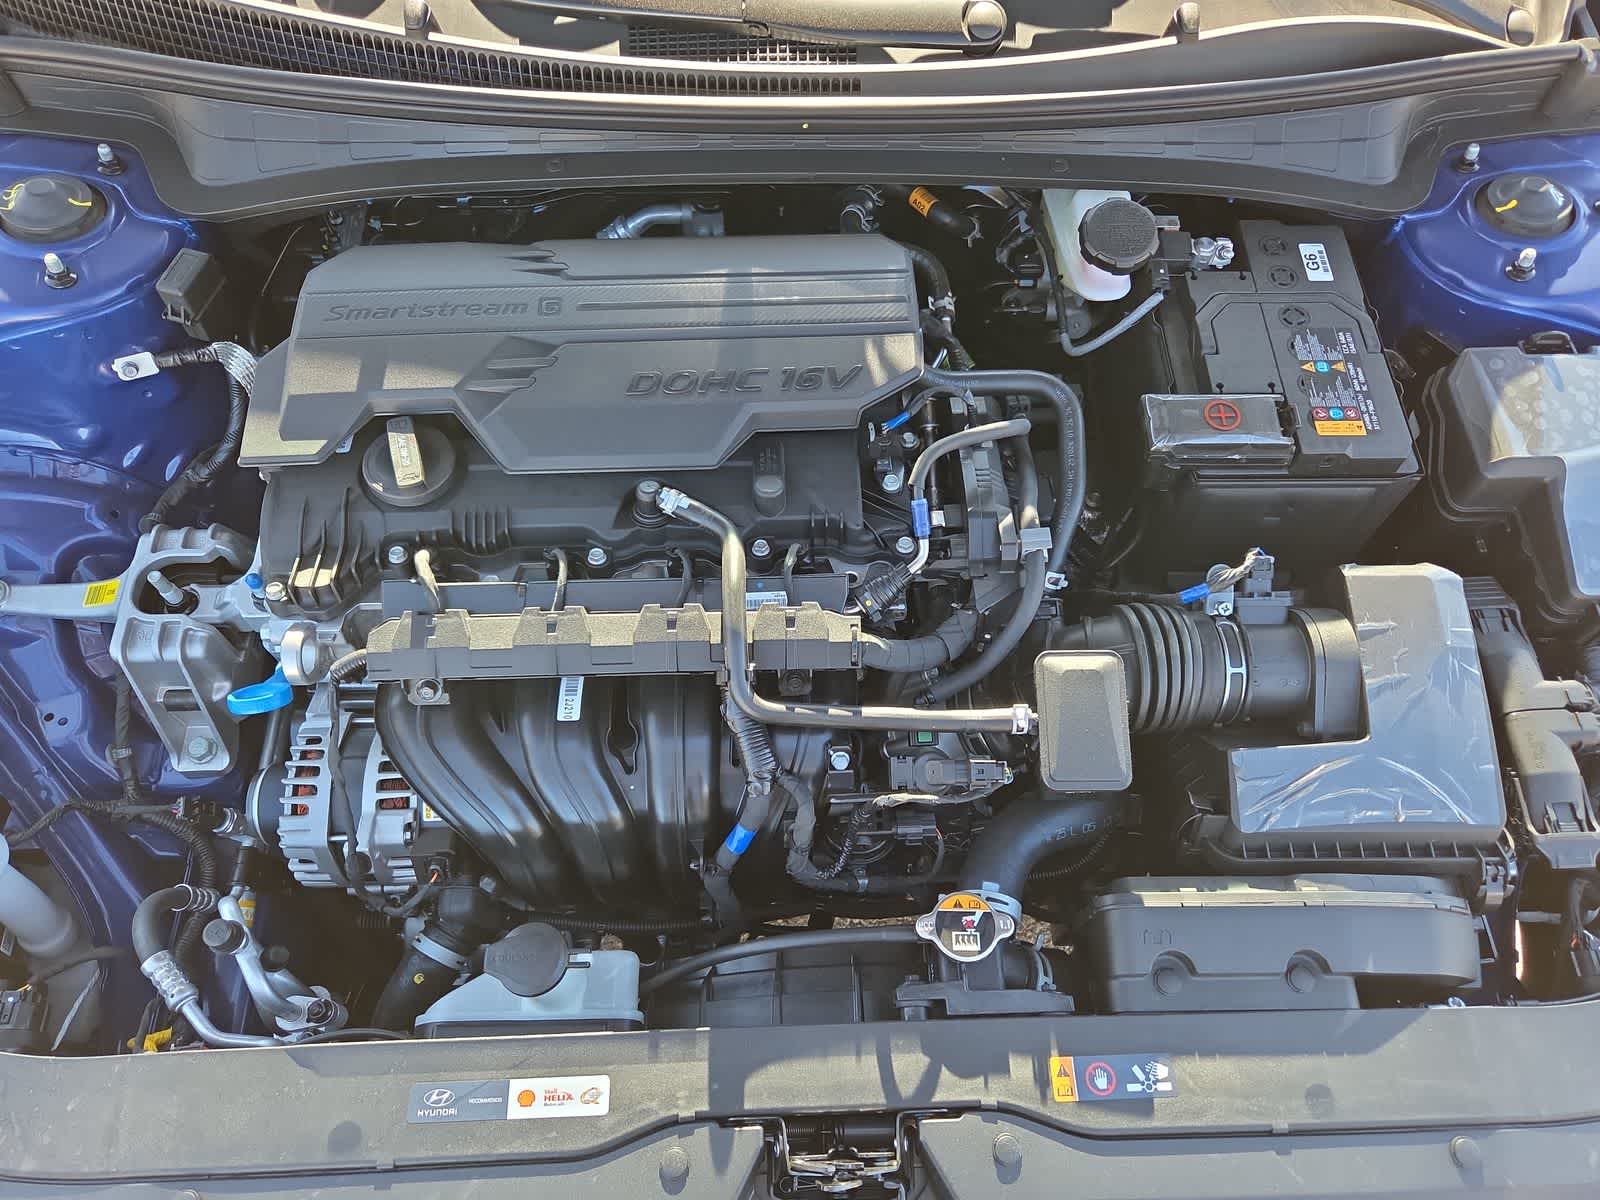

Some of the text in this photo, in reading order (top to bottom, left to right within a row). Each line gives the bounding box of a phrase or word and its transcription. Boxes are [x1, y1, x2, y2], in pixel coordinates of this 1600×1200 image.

[1303, 253, 1320, 271] G6
[321, 302, 530, 323] Smartstream
[623, 363, 864, 397] DOHC 16V
[544, 1093, 574, 1102] HELIX
[417, 1107, 458, 1118] HYUNDAI
